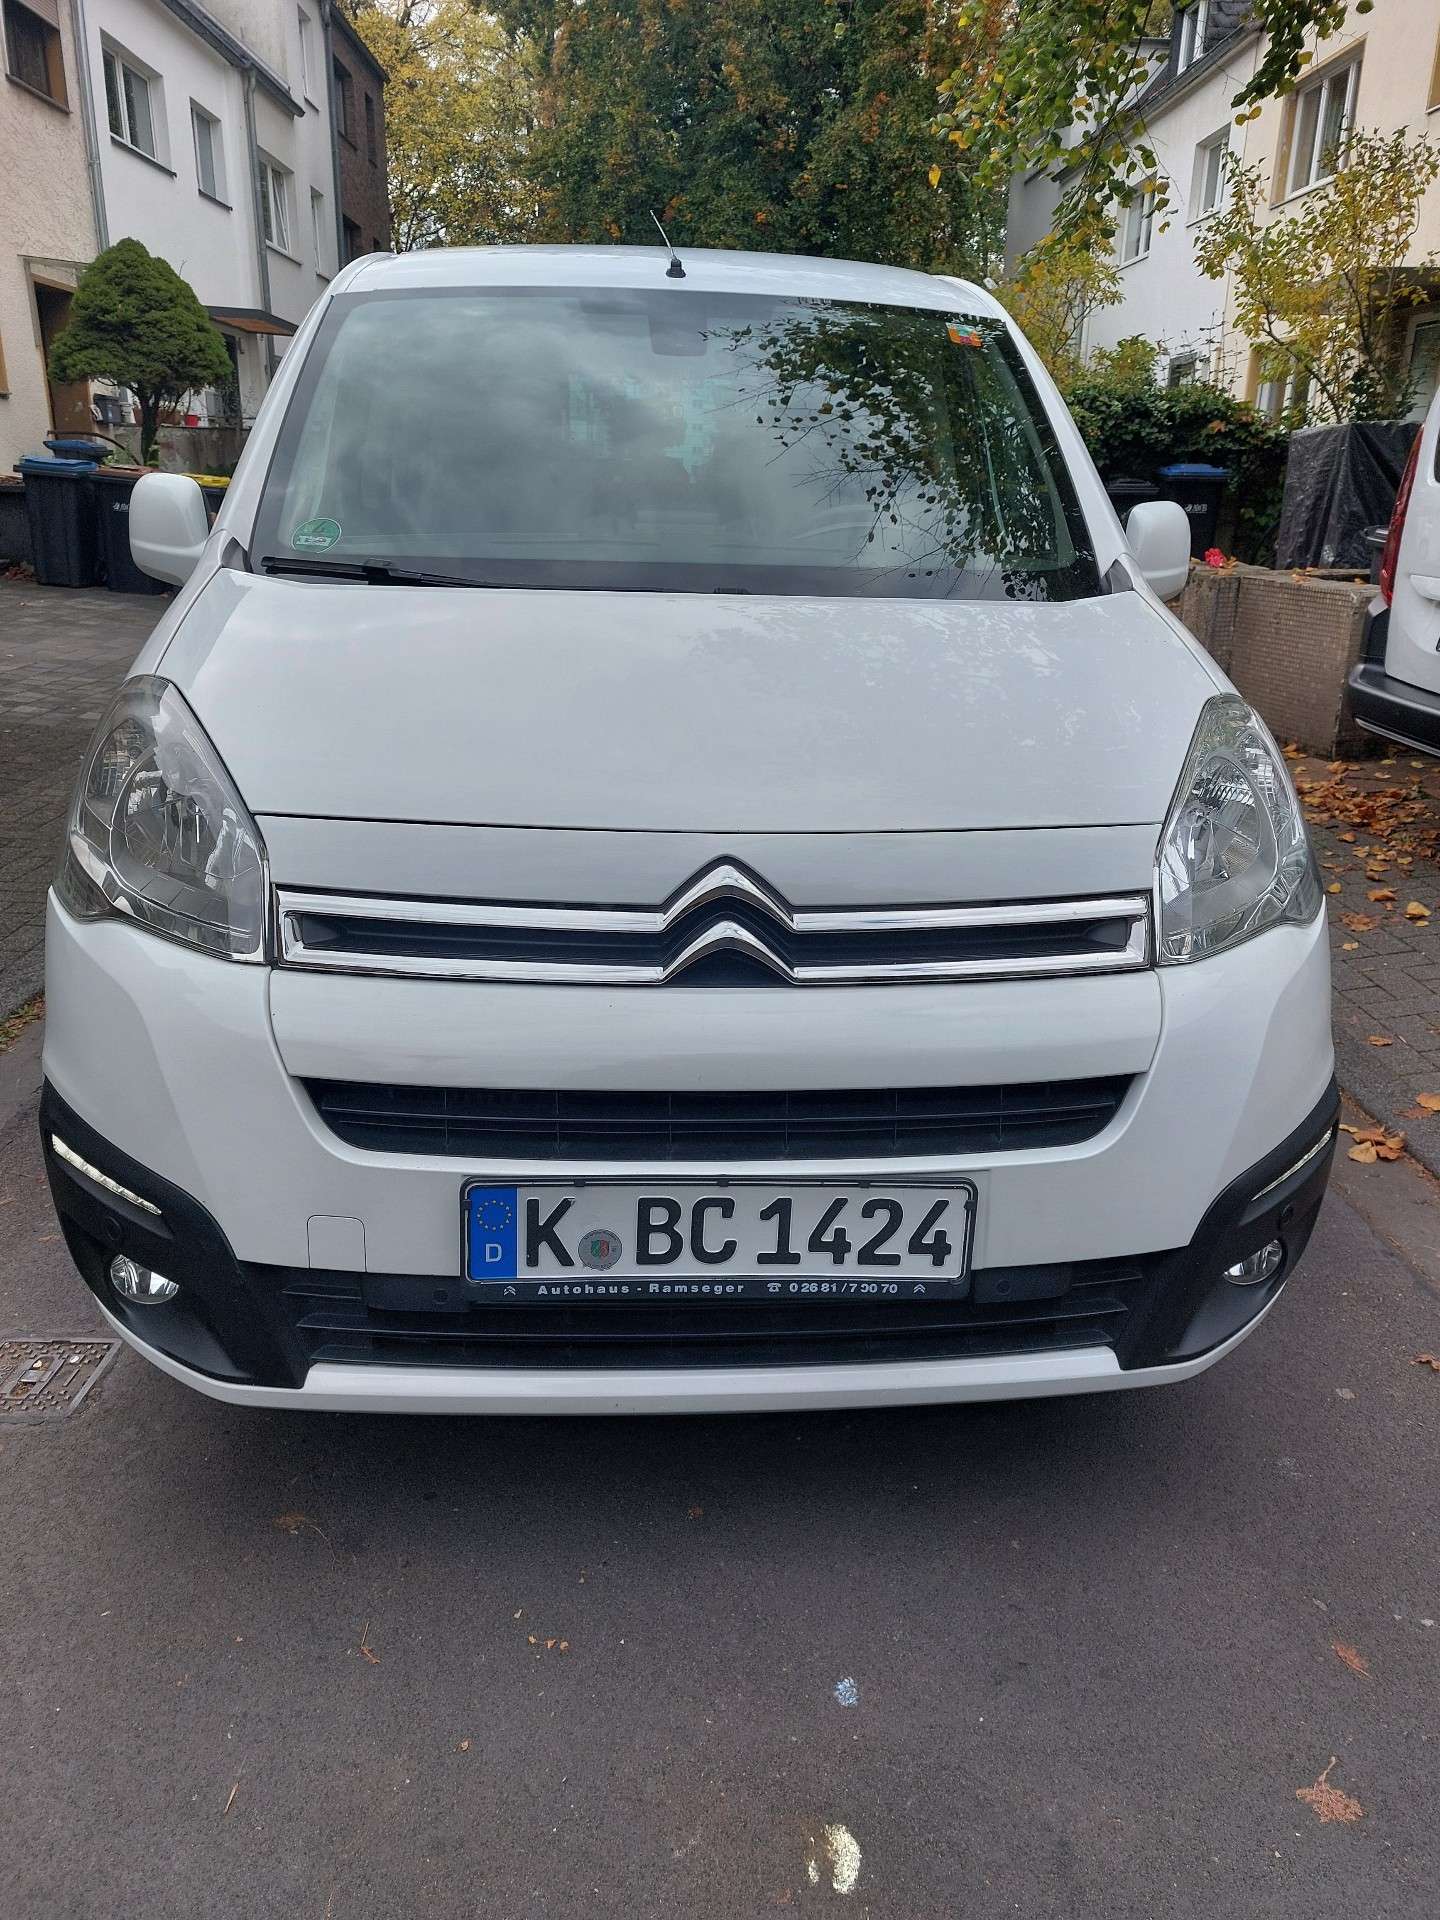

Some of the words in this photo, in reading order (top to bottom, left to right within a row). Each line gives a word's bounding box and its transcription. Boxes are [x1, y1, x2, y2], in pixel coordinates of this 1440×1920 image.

[526, 1198, 575, 1267] K
[636, 1198, 738, 1265] BC
[757, 1198, 952, 1266] 1424
[485, 1243, 502, 1263] D
[538, 1284, 630, 1295] Autohaus
[649, 1283, 744, 1295] Ramseger
